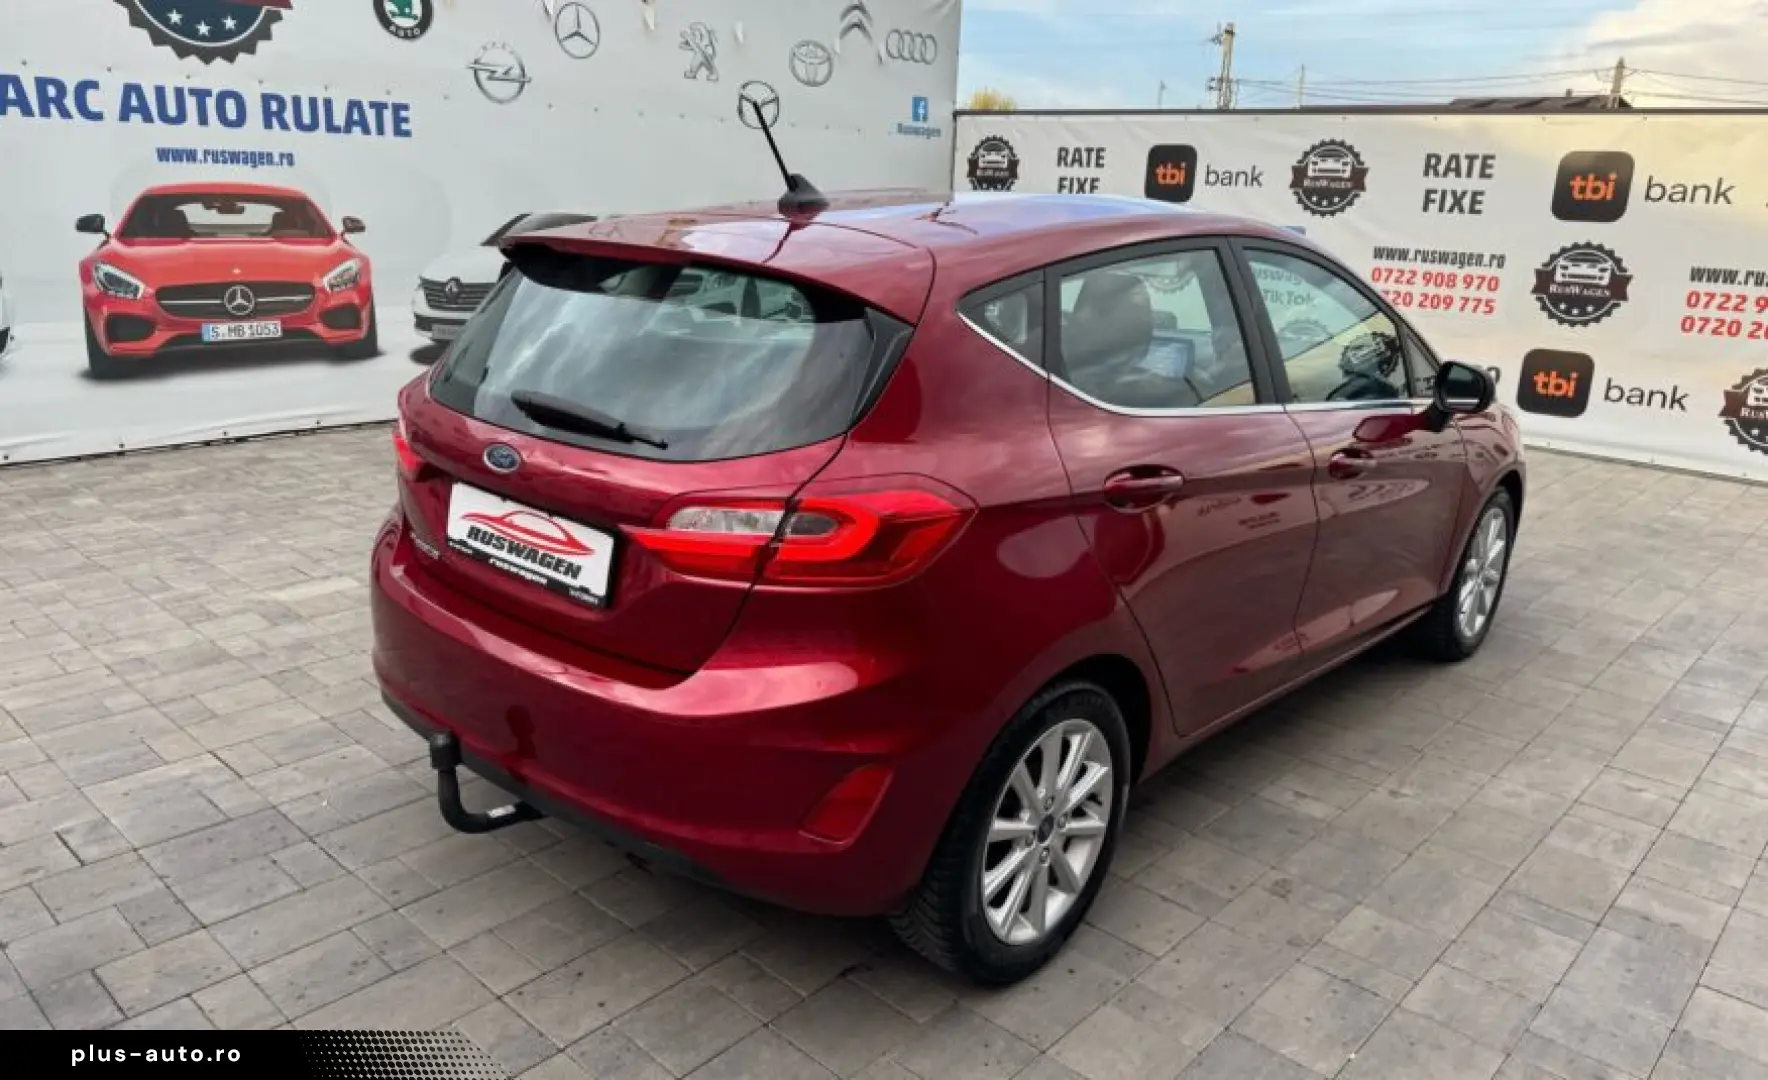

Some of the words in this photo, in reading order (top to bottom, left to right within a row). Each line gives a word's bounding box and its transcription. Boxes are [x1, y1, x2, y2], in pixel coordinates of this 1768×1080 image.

[0, 74, 104, 121] ARC
[119, 82, 247, 128] AUTO
[260, 92, 412, 137] RULATE
[155, 146, 296, 168] www.ruswagen.ro
[1056, 146, 1106, 168] RATE
[1422, 152, 1496, 180] RATE
[1155, 161, 1186, 187] tbi
[1204, 163, 1264, 188] bank
[1422, 188, 1486, 215] FIXE
[1569, 172, 1617, 201] tbi
[1644, 175, 1736, 205] bank
[1373, 245, 1506, 269] www.ruswagen.ro
[1371, 267, 1418, 285] 0722
[1422, 271, 1458, 289] 908
[1462, 274, 1500, 292] 970
[1418, 293, 1454, 310] 209
[1459, 297, 1496, 315] 775
[1686, 290, 1748, 312] 0722
[1680, 315, 1742, 338] 0720
[1534, 371, 1579, 398] tbi
[1603, 377, 1690, 412] bank
[466, 525, 582, 580] RUSWAGEN
